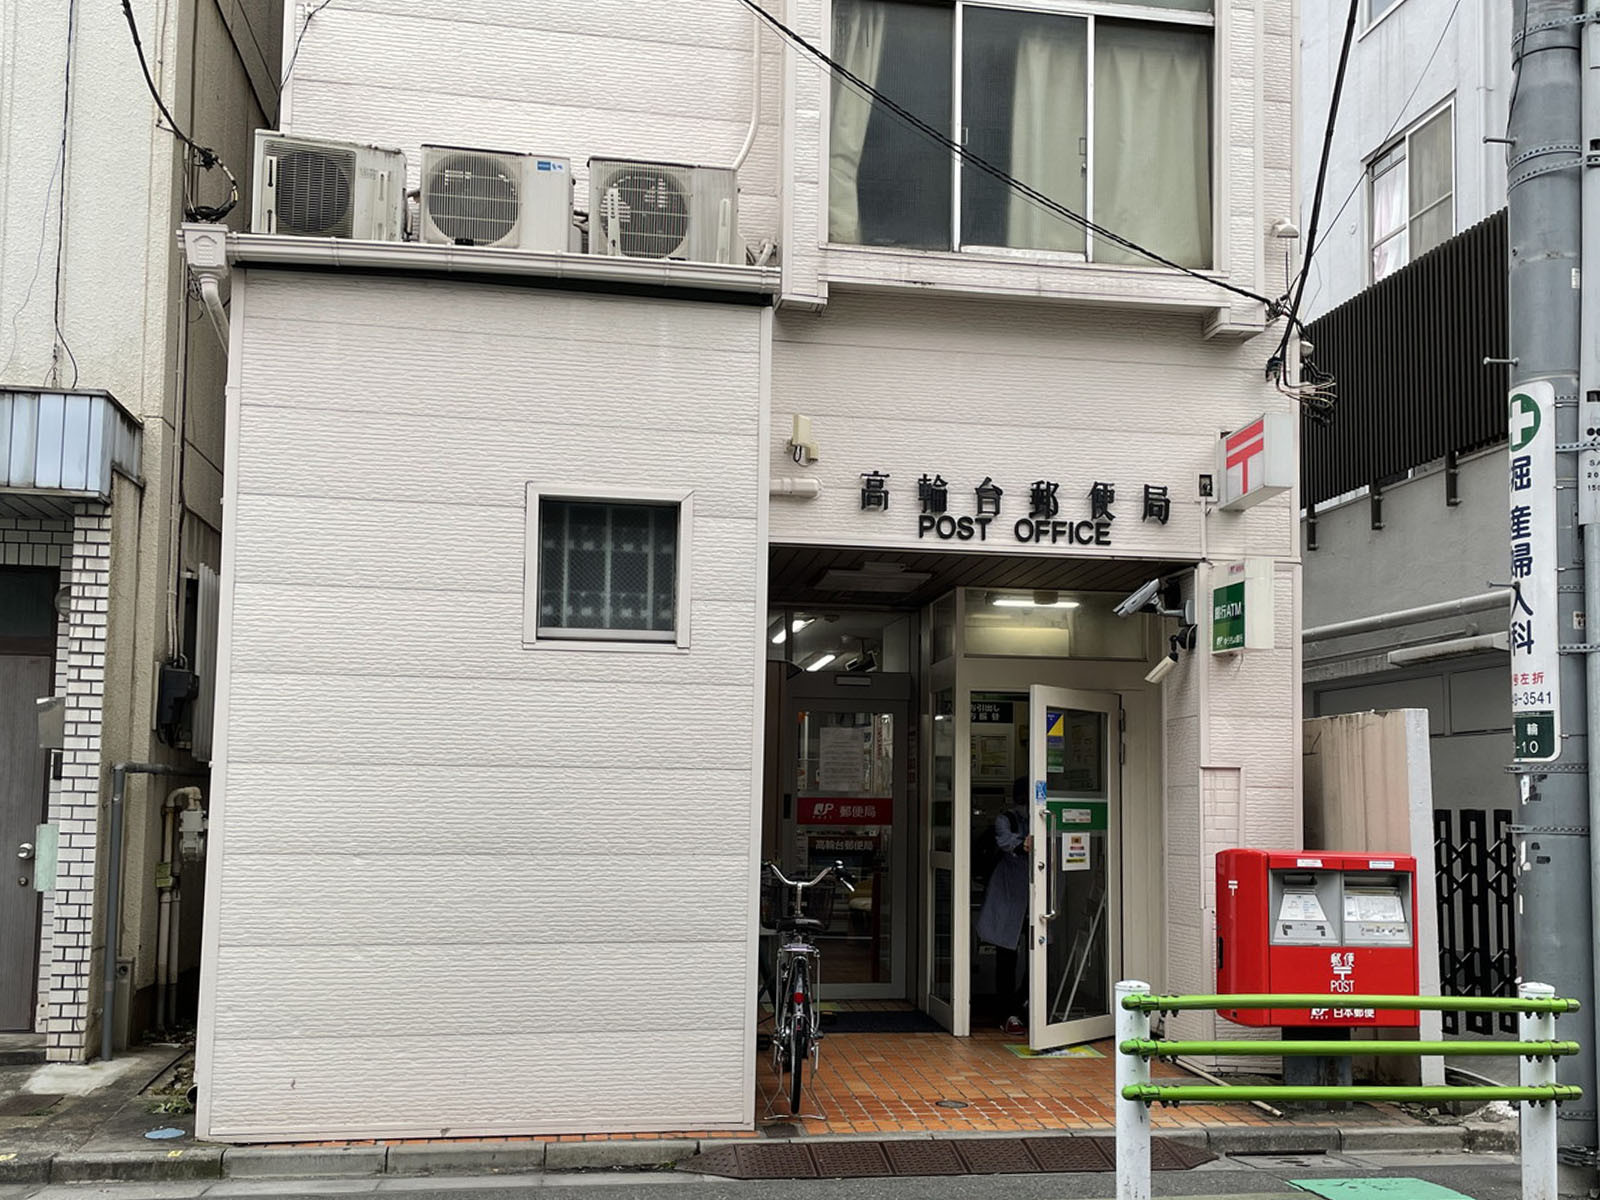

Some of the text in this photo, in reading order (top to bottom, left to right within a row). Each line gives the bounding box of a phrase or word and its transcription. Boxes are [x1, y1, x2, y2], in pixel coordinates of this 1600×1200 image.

[859, 470, 1172, 525] 高輪台郵便局
[918, 514, 1113, 546] POST OFFICE
[840, 805, 876, 818] 郵便局
[1331, 952, 1354, 967] 郵便
[1330, 980, 1354, 992] POST
[1333, 1008, 1375, 1018] 日本郵便
